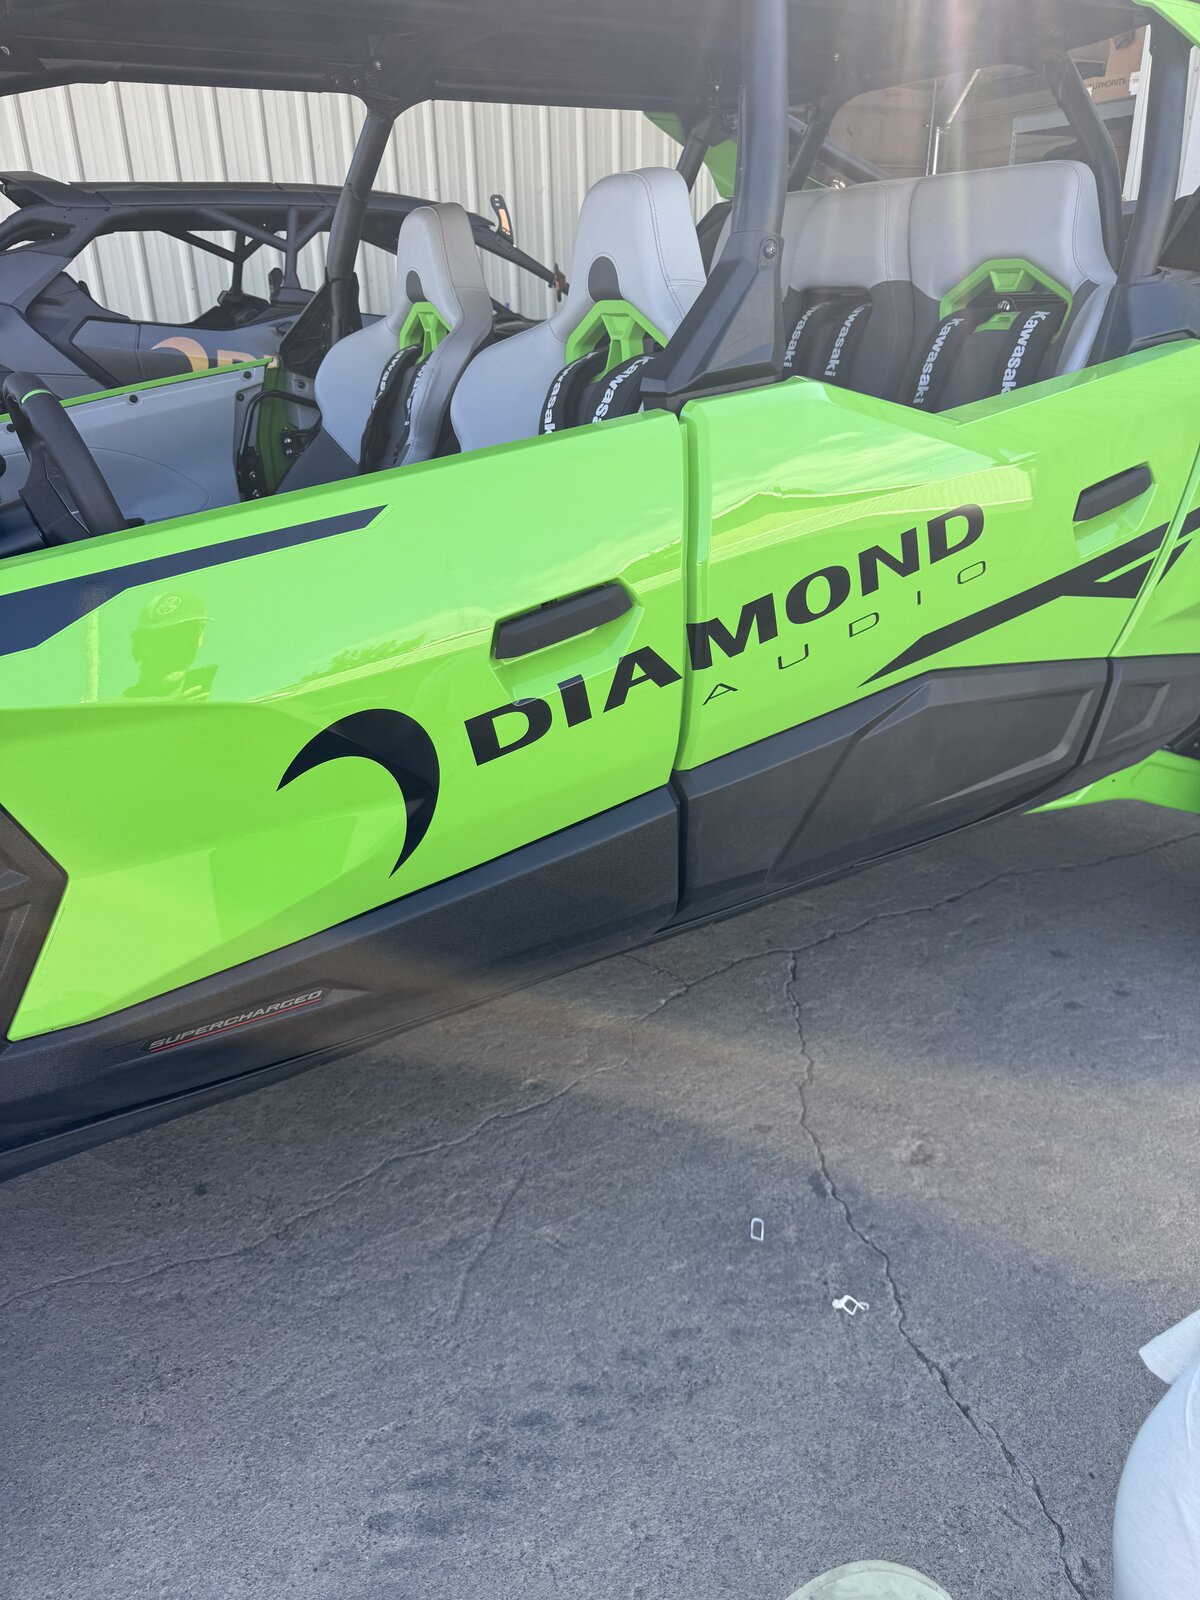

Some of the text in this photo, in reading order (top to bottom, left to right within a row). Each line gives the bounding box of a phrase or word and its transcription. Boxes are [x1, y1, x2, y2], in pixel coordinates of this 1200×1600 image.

[912, 317, 965, 404] Kawasaki
[1000, 310, 1051, 394] Kawasak
[463, 503, 985, 766] DIAMOND
[702, 560, 987, 706] AUDIO
[148, 989, 322, 1050] SUPERCHARGED
